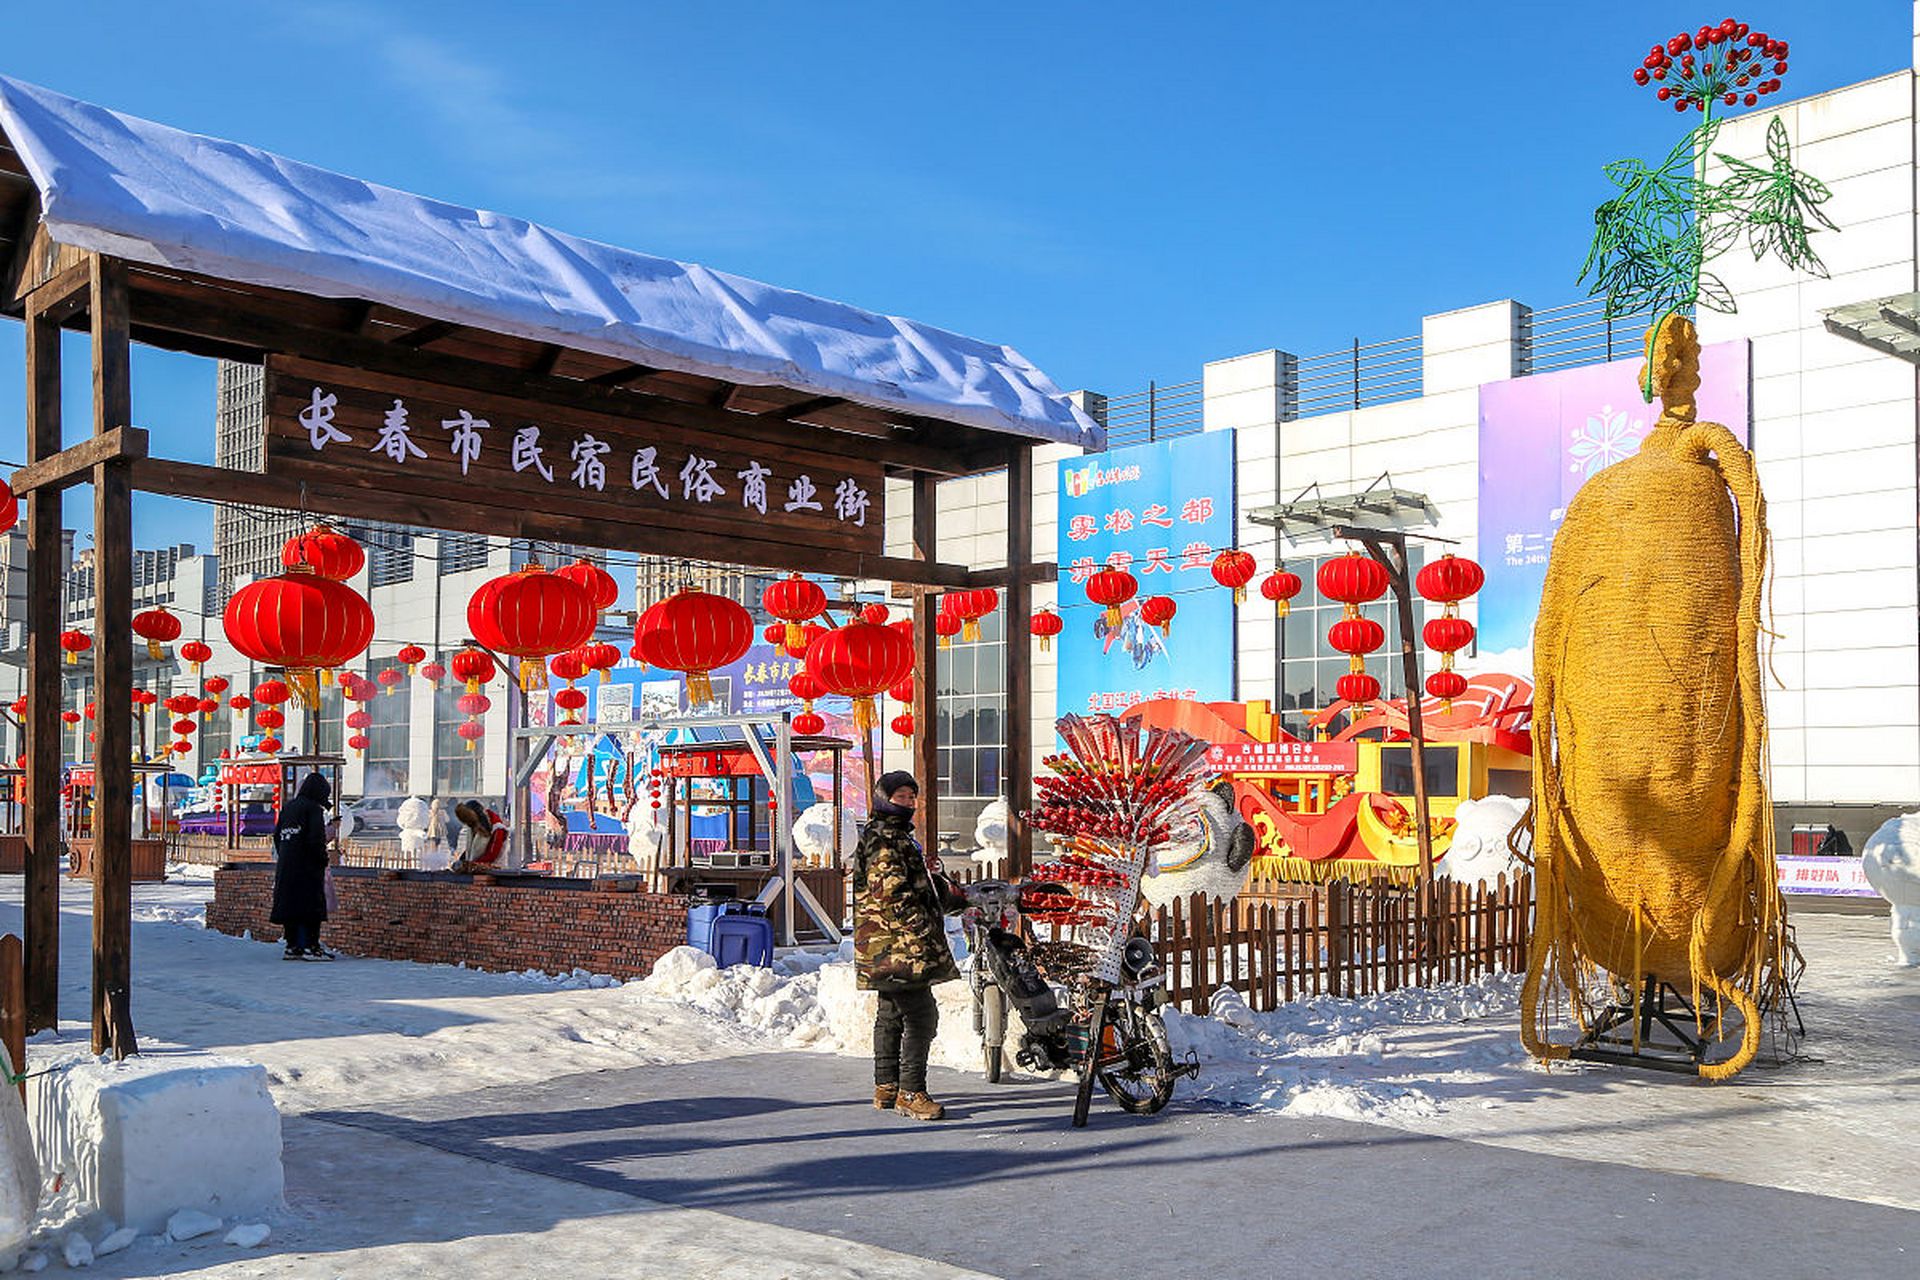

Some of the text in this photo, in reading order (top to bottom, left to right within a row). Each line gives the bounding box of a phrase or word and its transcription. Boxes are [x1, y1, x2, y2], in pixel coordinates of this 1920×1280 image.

[298, 386, 871, 527] 长春市民宿民俗商业街
[1068, 497, 1214, 540] 雾凇之都
